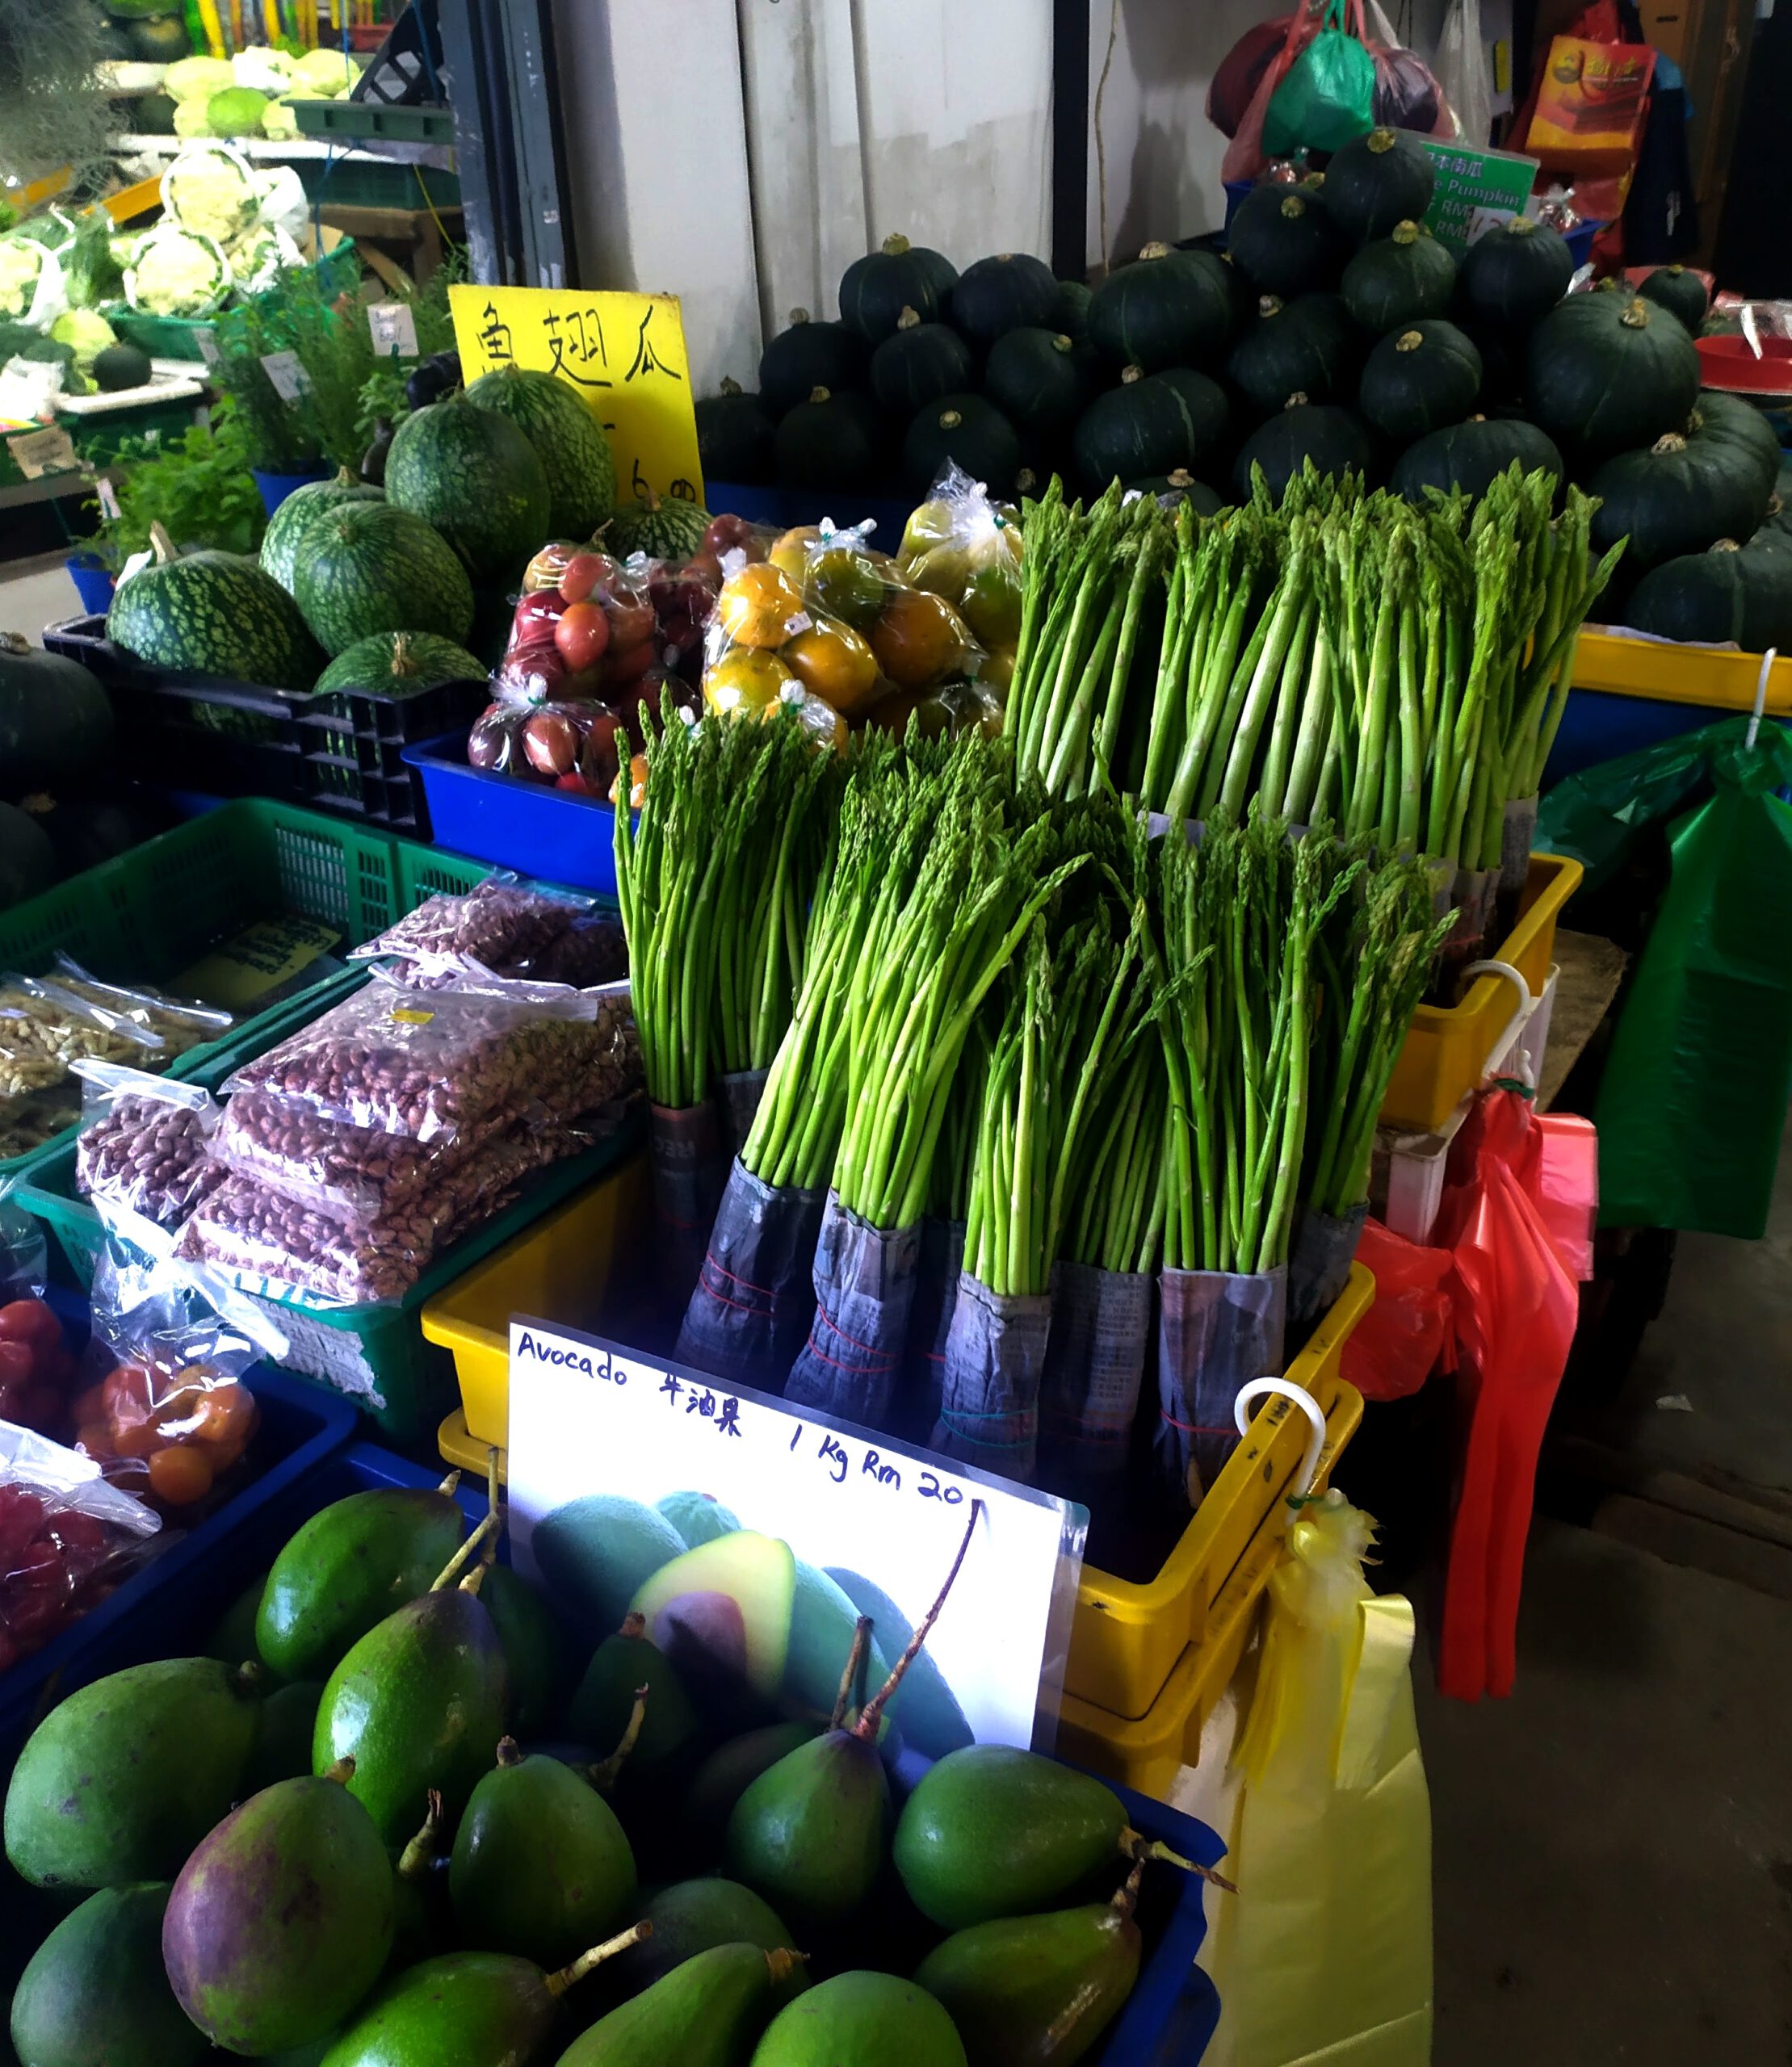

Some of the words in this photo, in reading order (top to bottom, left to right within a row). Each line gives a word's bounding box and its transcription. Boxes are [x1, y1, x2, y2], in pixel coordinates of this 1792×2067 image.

[1448, 179, 1520, 206] Pumpkin
[518, 1331, 627, 1386] Avocado
[659, 1373, 742, 1438] 牛油果
[917, 1472, 963, 1504] 20
